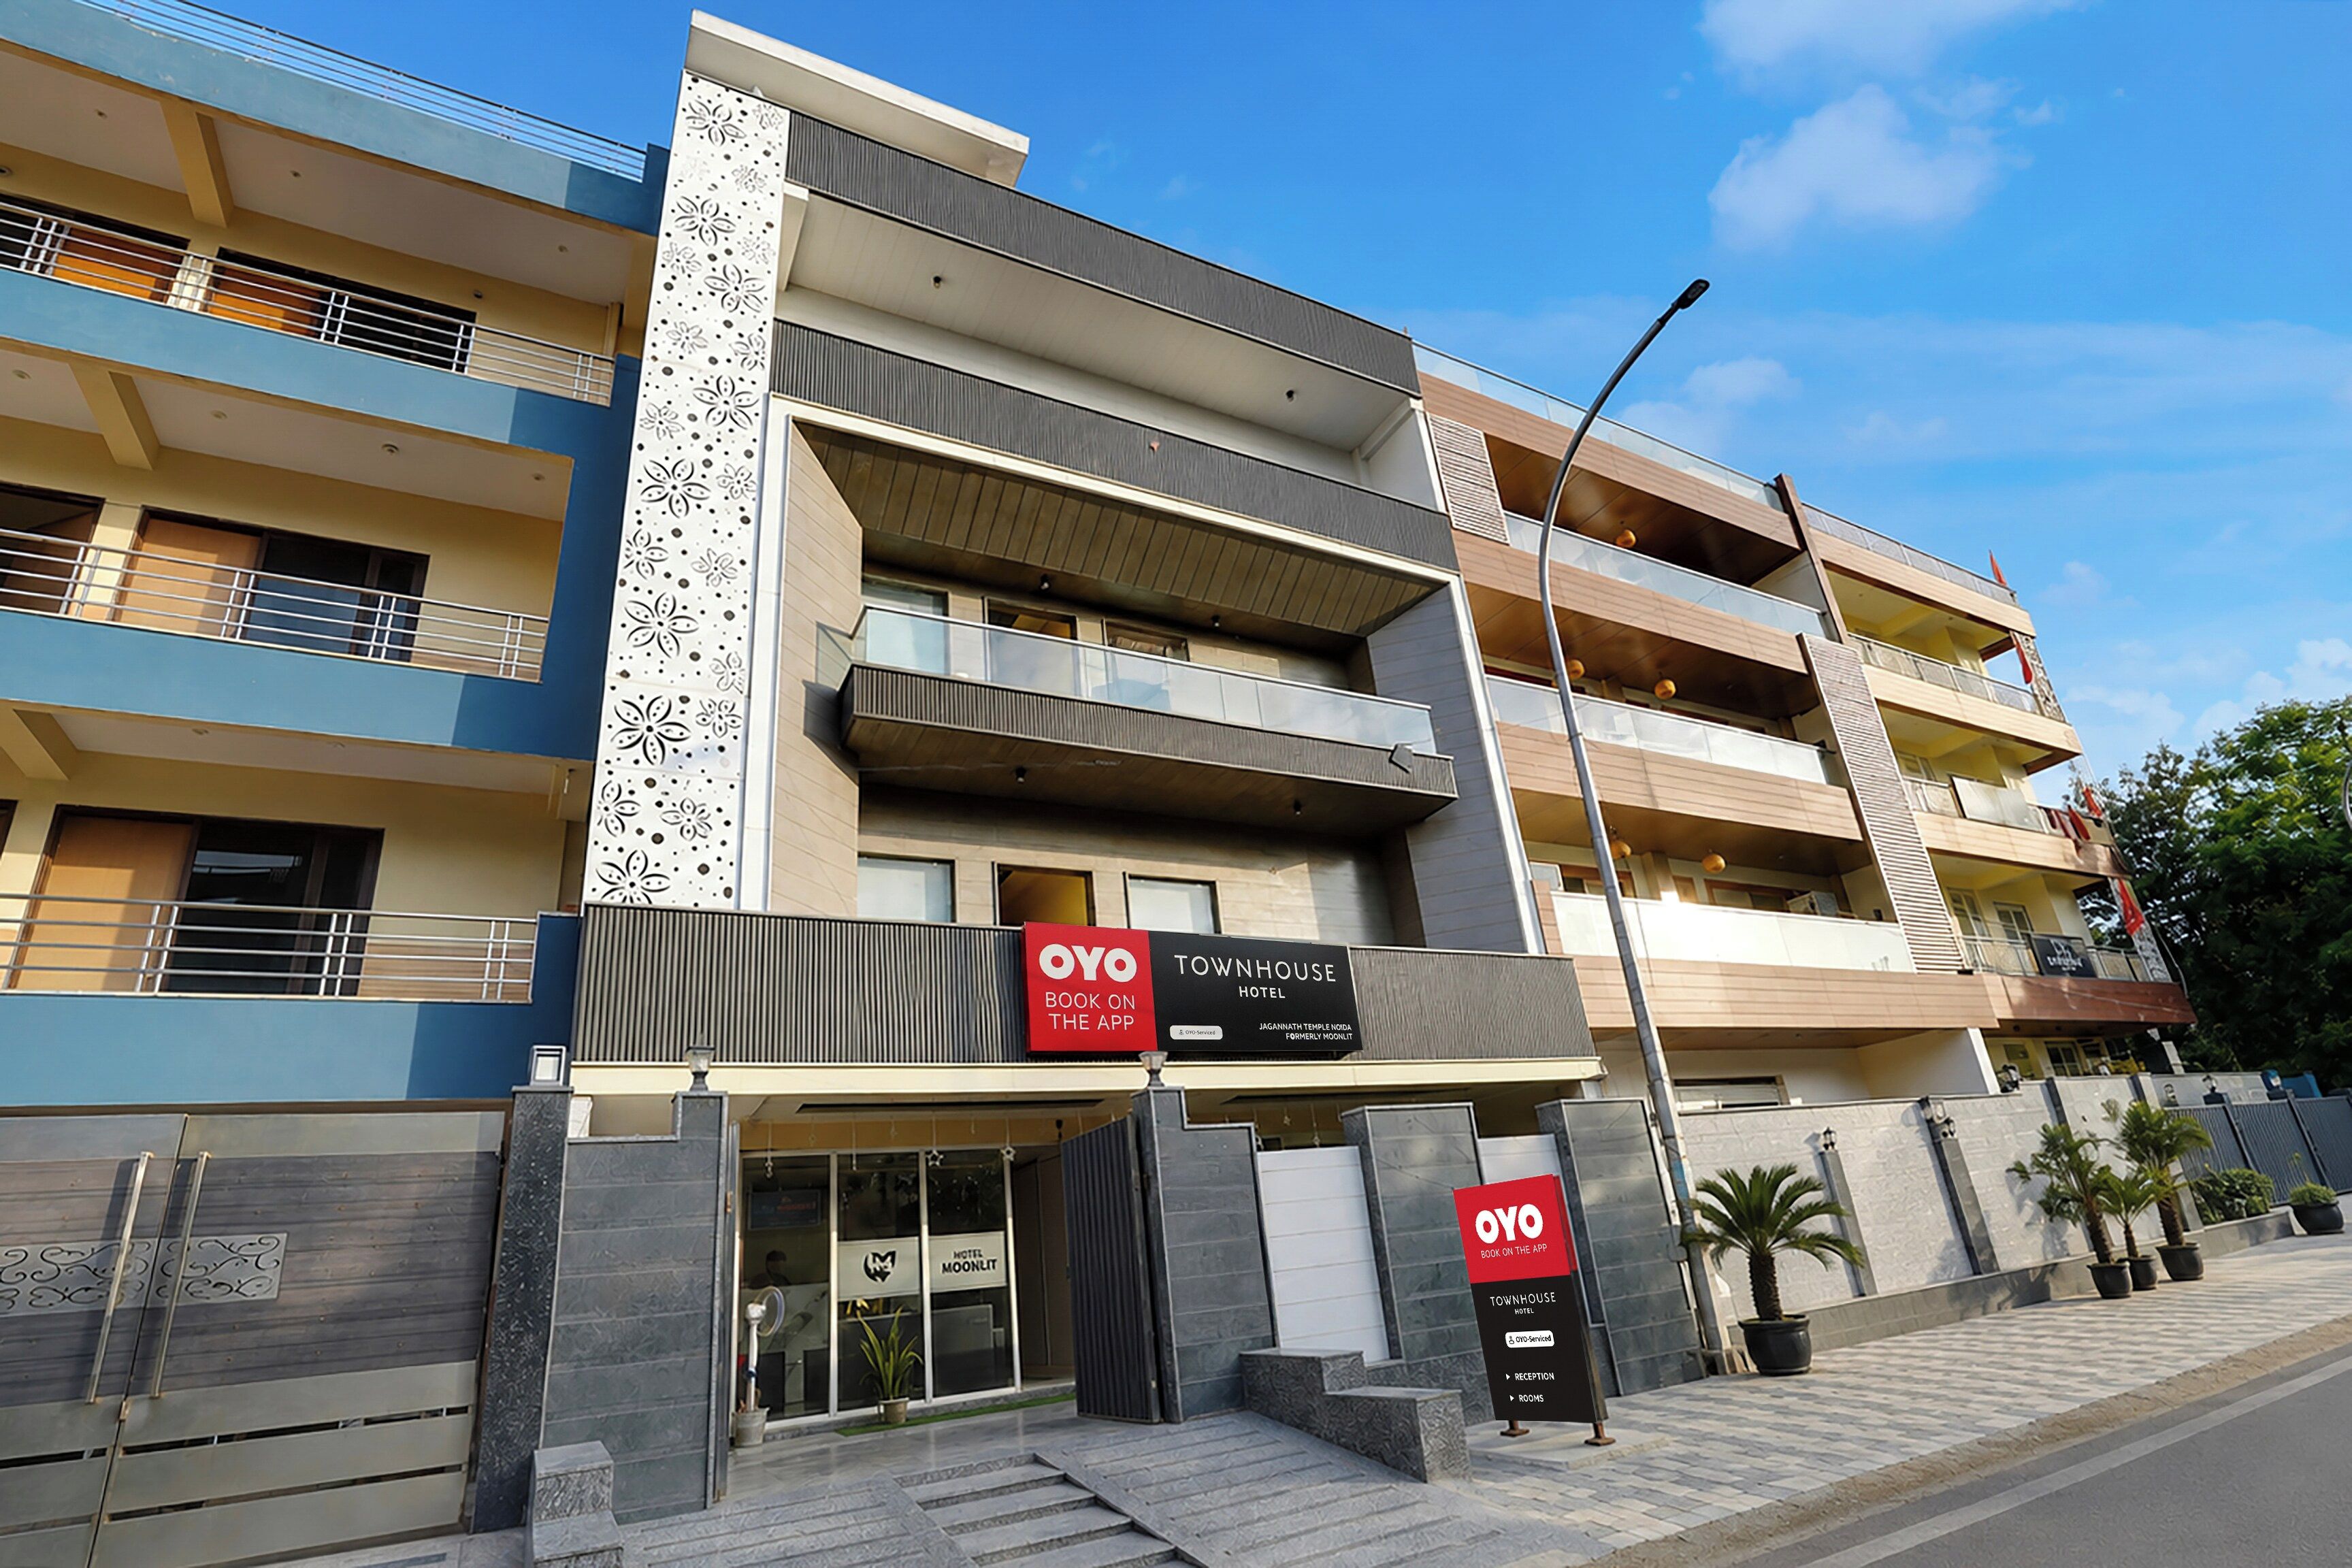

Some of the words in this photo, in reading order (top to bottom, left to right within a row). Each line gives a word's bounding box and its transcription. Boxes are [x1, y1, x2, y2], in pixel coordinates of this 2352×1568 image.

[1039, 943, 1137, 983] OYO
[1174, 954, 1336, 982] TOWNHOUSE
[1239, 985, 1286, 999] HOTEL
[1045, 992, 1101, 1009] BOOK
[1108, 994, 1135, 1010] ON
[1048, 1013, 1090, 1030] THE
[1097, 1015, 1134, 1030] APP
[1259, 1022, 1303, 1030] JAGANNATH
[1303, 1023, 1330, 1031] TEMPLE
[1286, 1032, 1322, 1041] FORMERLY
[1323, 1032, 1353, 1041] MOONLIT
[1475, 1203, 1544, 1244] OYO
[953, 1249, 983, 1259] HOTEL
[1480, 1248, 1501, 1259] BOOK
[1502, 1247, 1514, 1256] ON
[1514, 1245, 1531, 1255] THE
[1533, 1243, 1548, 1254] APP
[942, 1258, 997, 1274] MOONLIT
[1490, 1292, 1556, 1307] TOWNHOUSE
[1516, 1335, 1552, 1343] OYO-Serviced
[1514, 1372, 1555, 1381] RECEPTION
[1518, 1394, 1544, 1403] ROOMS
